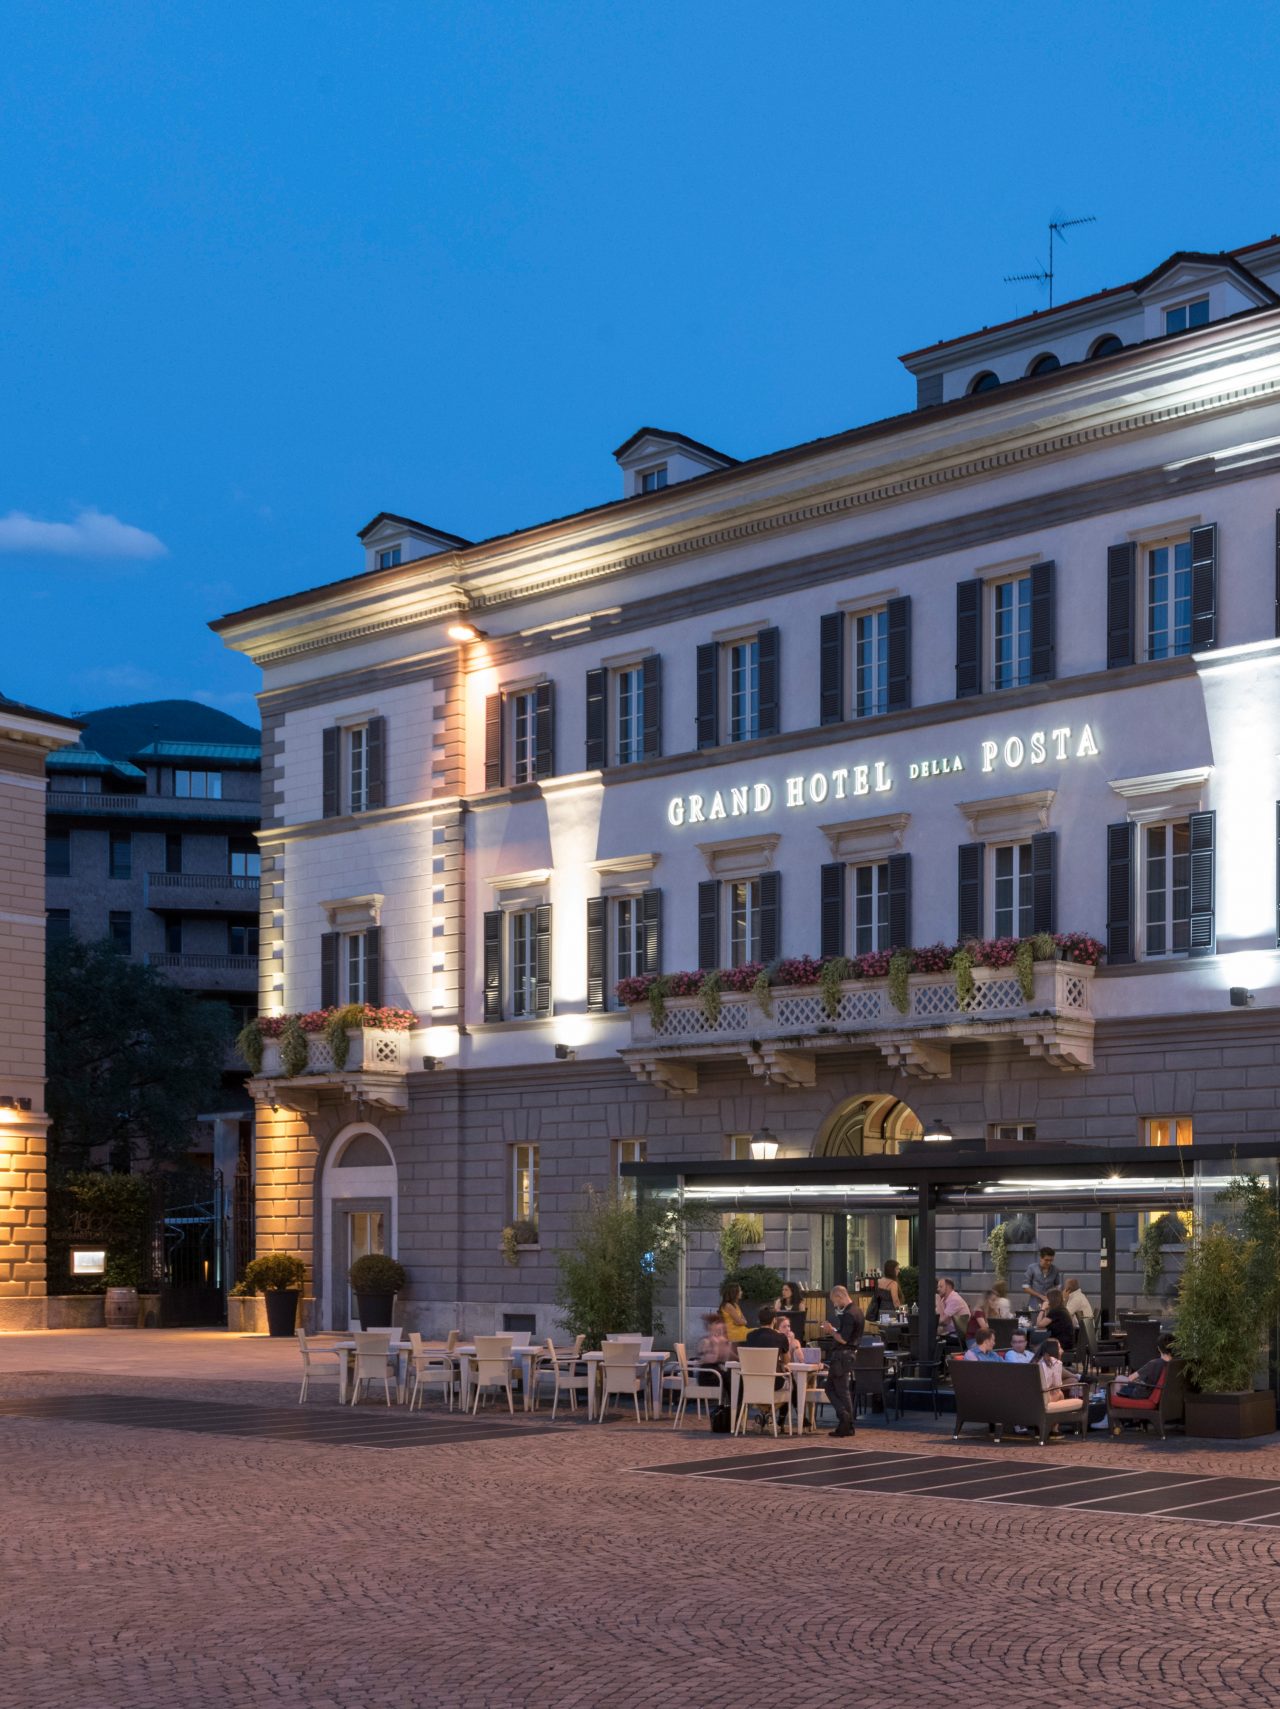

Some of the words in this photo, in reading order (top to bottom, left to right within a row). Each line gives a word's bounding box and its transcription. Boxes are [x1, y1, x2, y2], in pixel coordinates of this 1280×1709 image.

[667, 782, 773, 827] GRAND
[785, 761, 893, 808] HOTEL
[909, 755, 965, 780] DELLA
[981, 723, 1099, 773] POSTA
